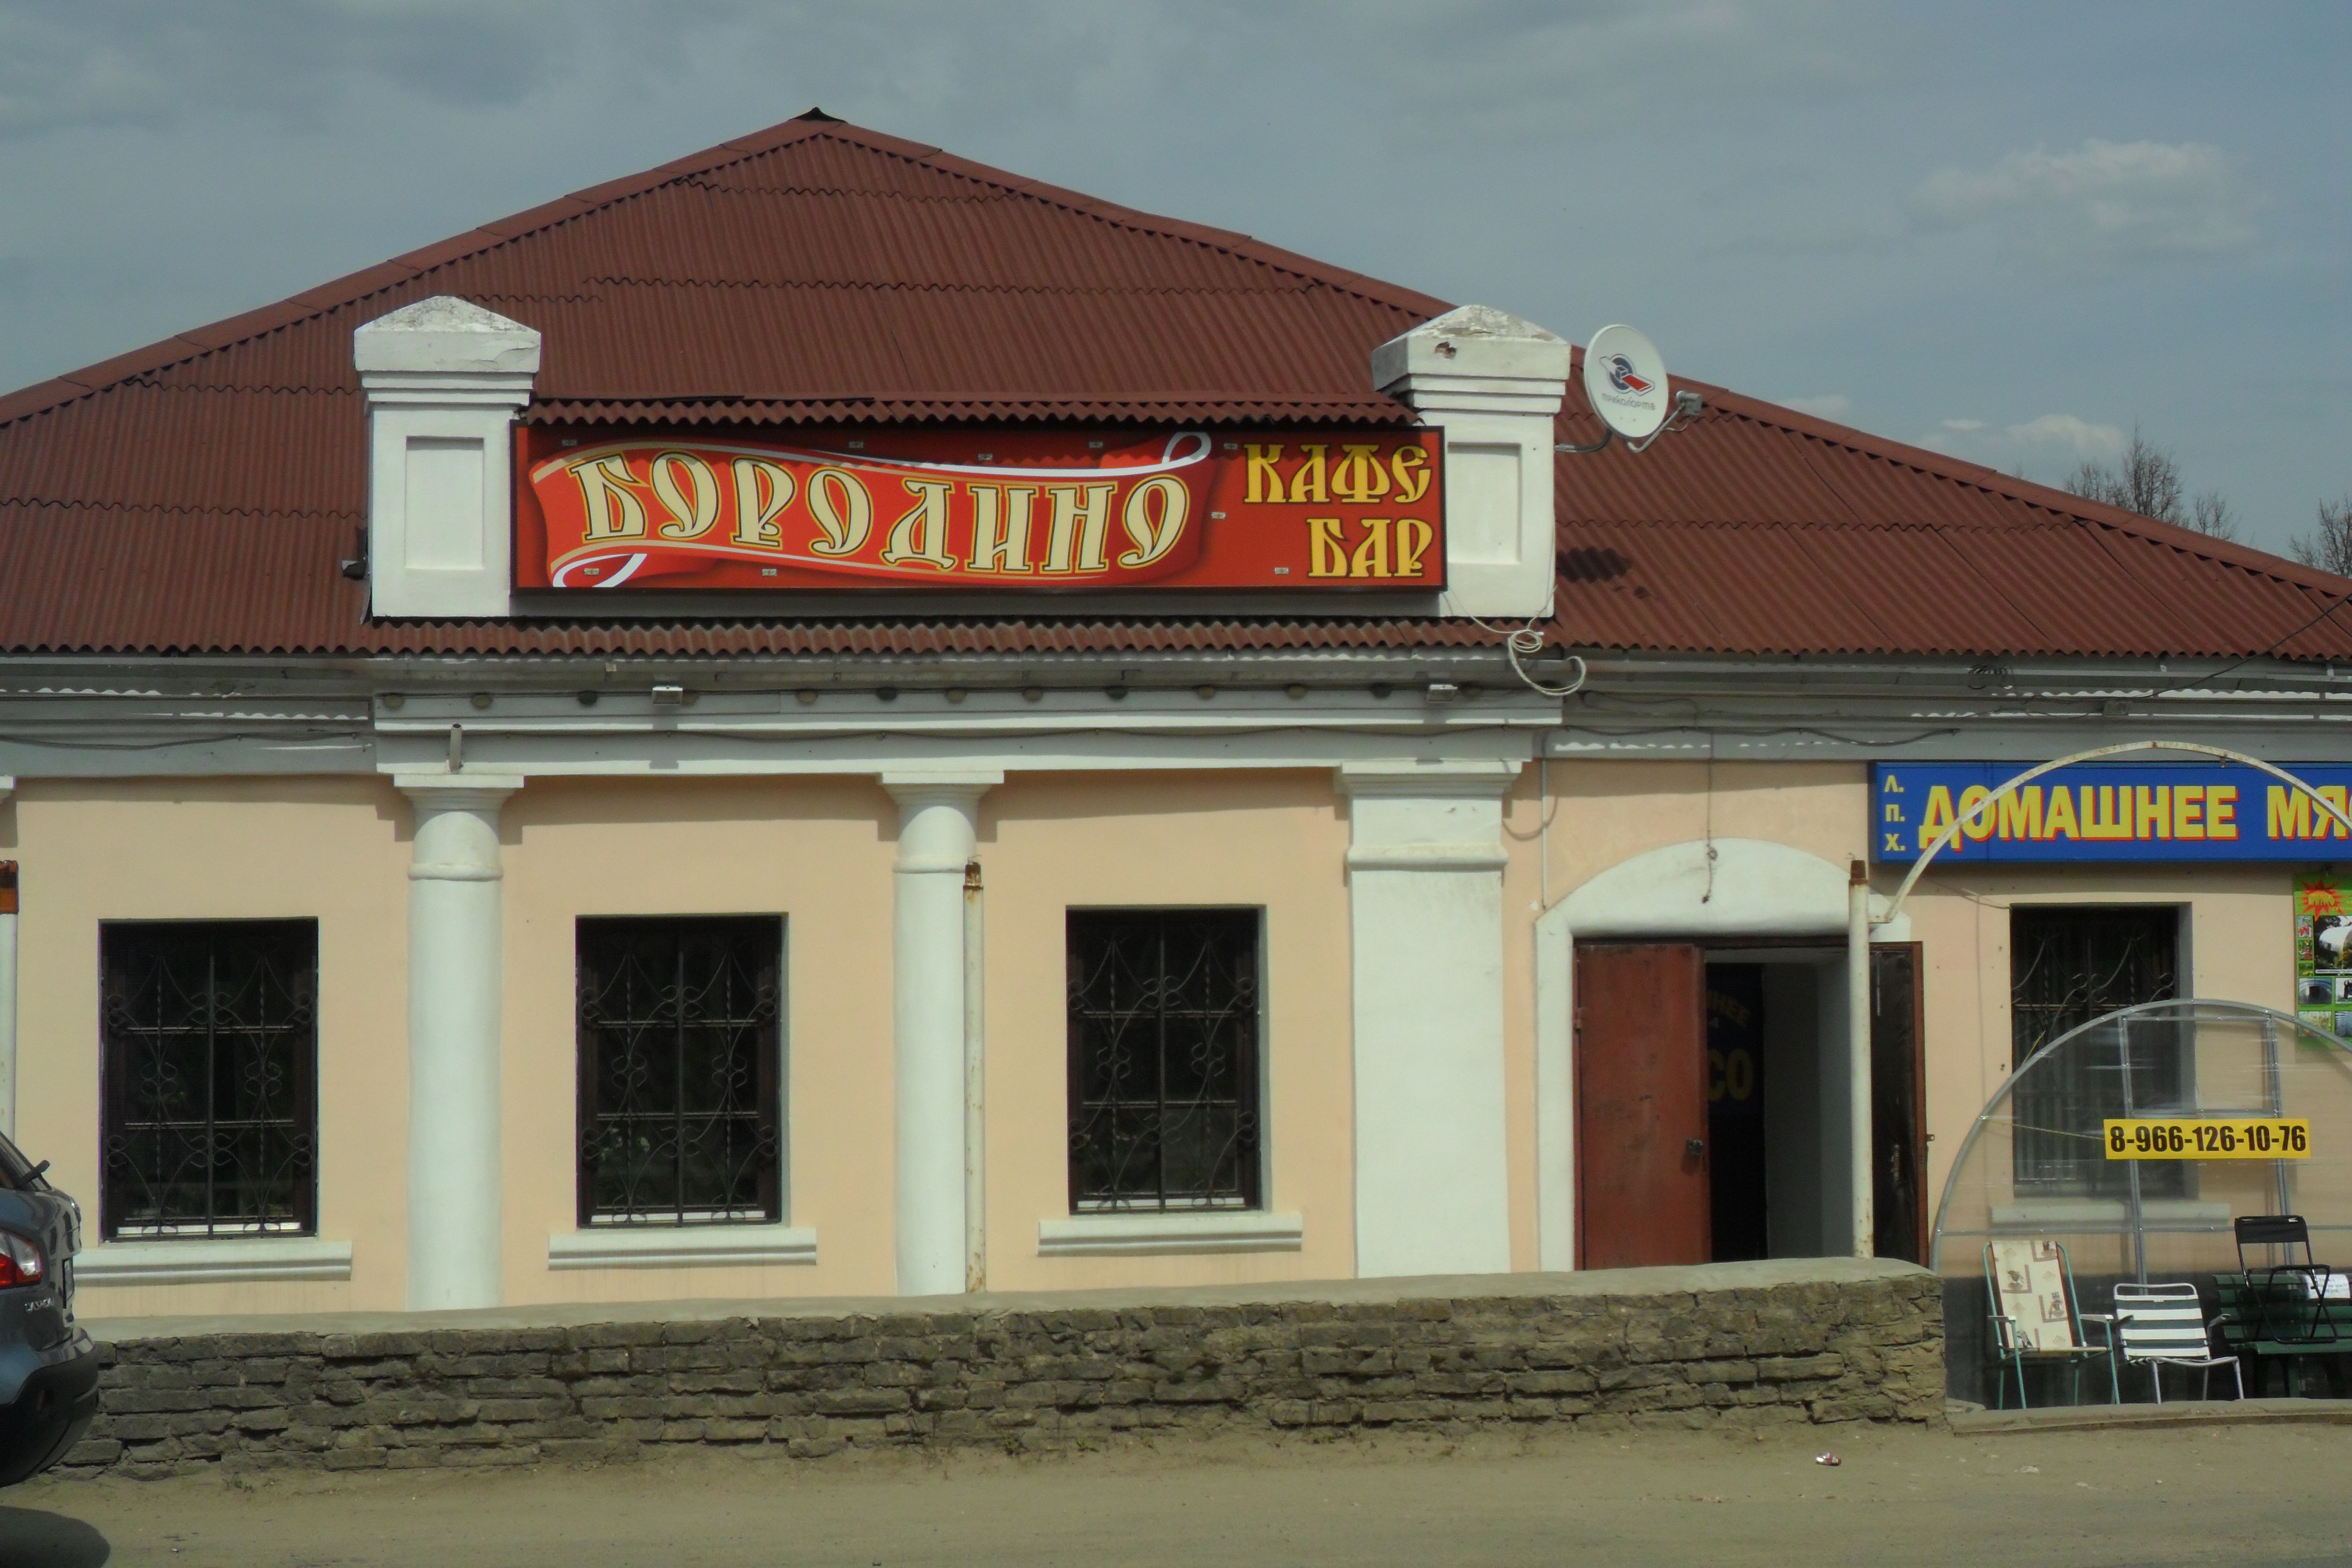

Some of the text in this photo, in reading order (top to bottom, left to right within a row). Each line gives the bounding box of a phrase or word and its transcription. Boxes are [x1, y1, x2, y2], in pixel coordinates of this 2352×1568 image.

[1244, 444, 1432, 504] КАФЕ
[565, 449, 1190, 575] БОРОДИНО
[1306, 518, 1434, 578] БАР
[1918, 785, 2352, 853] ДОМАШНЕЕ МЯ
[2110, 1125, 2307, 1152] 8-966-126-10-76
